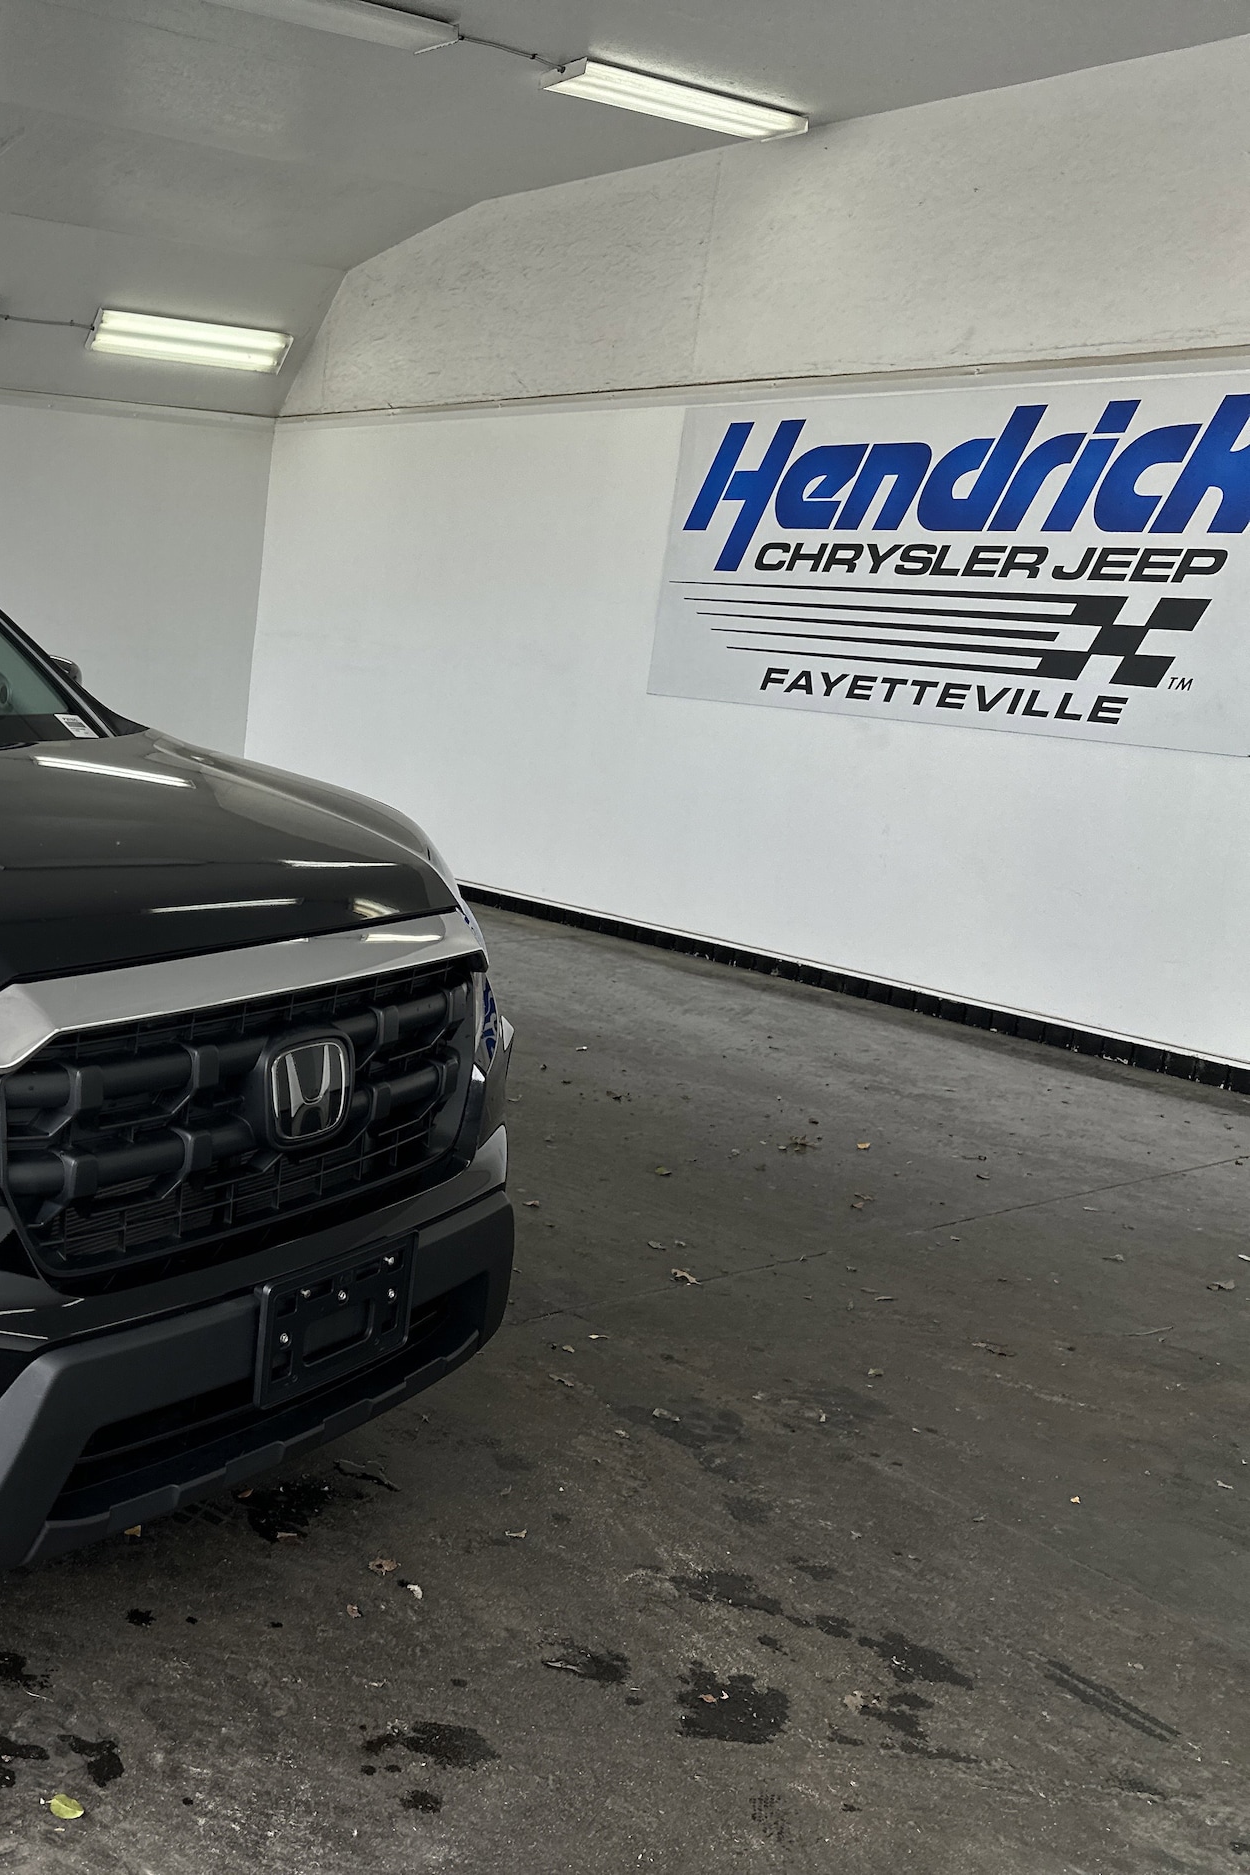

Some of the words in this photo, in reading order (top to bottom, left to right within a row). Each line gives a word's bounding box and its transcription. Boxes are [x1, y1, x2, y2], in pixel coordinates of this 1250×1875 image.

[682, 394, 1250, 571] Hendrick
[754, 542, 1049, 579] CHRYSLER
[1052, 547, 1229, 583] JEEP
[760, 667, 1129, 725] FAYETTEVILLE
[1168, 677, 1193, 691] TM
